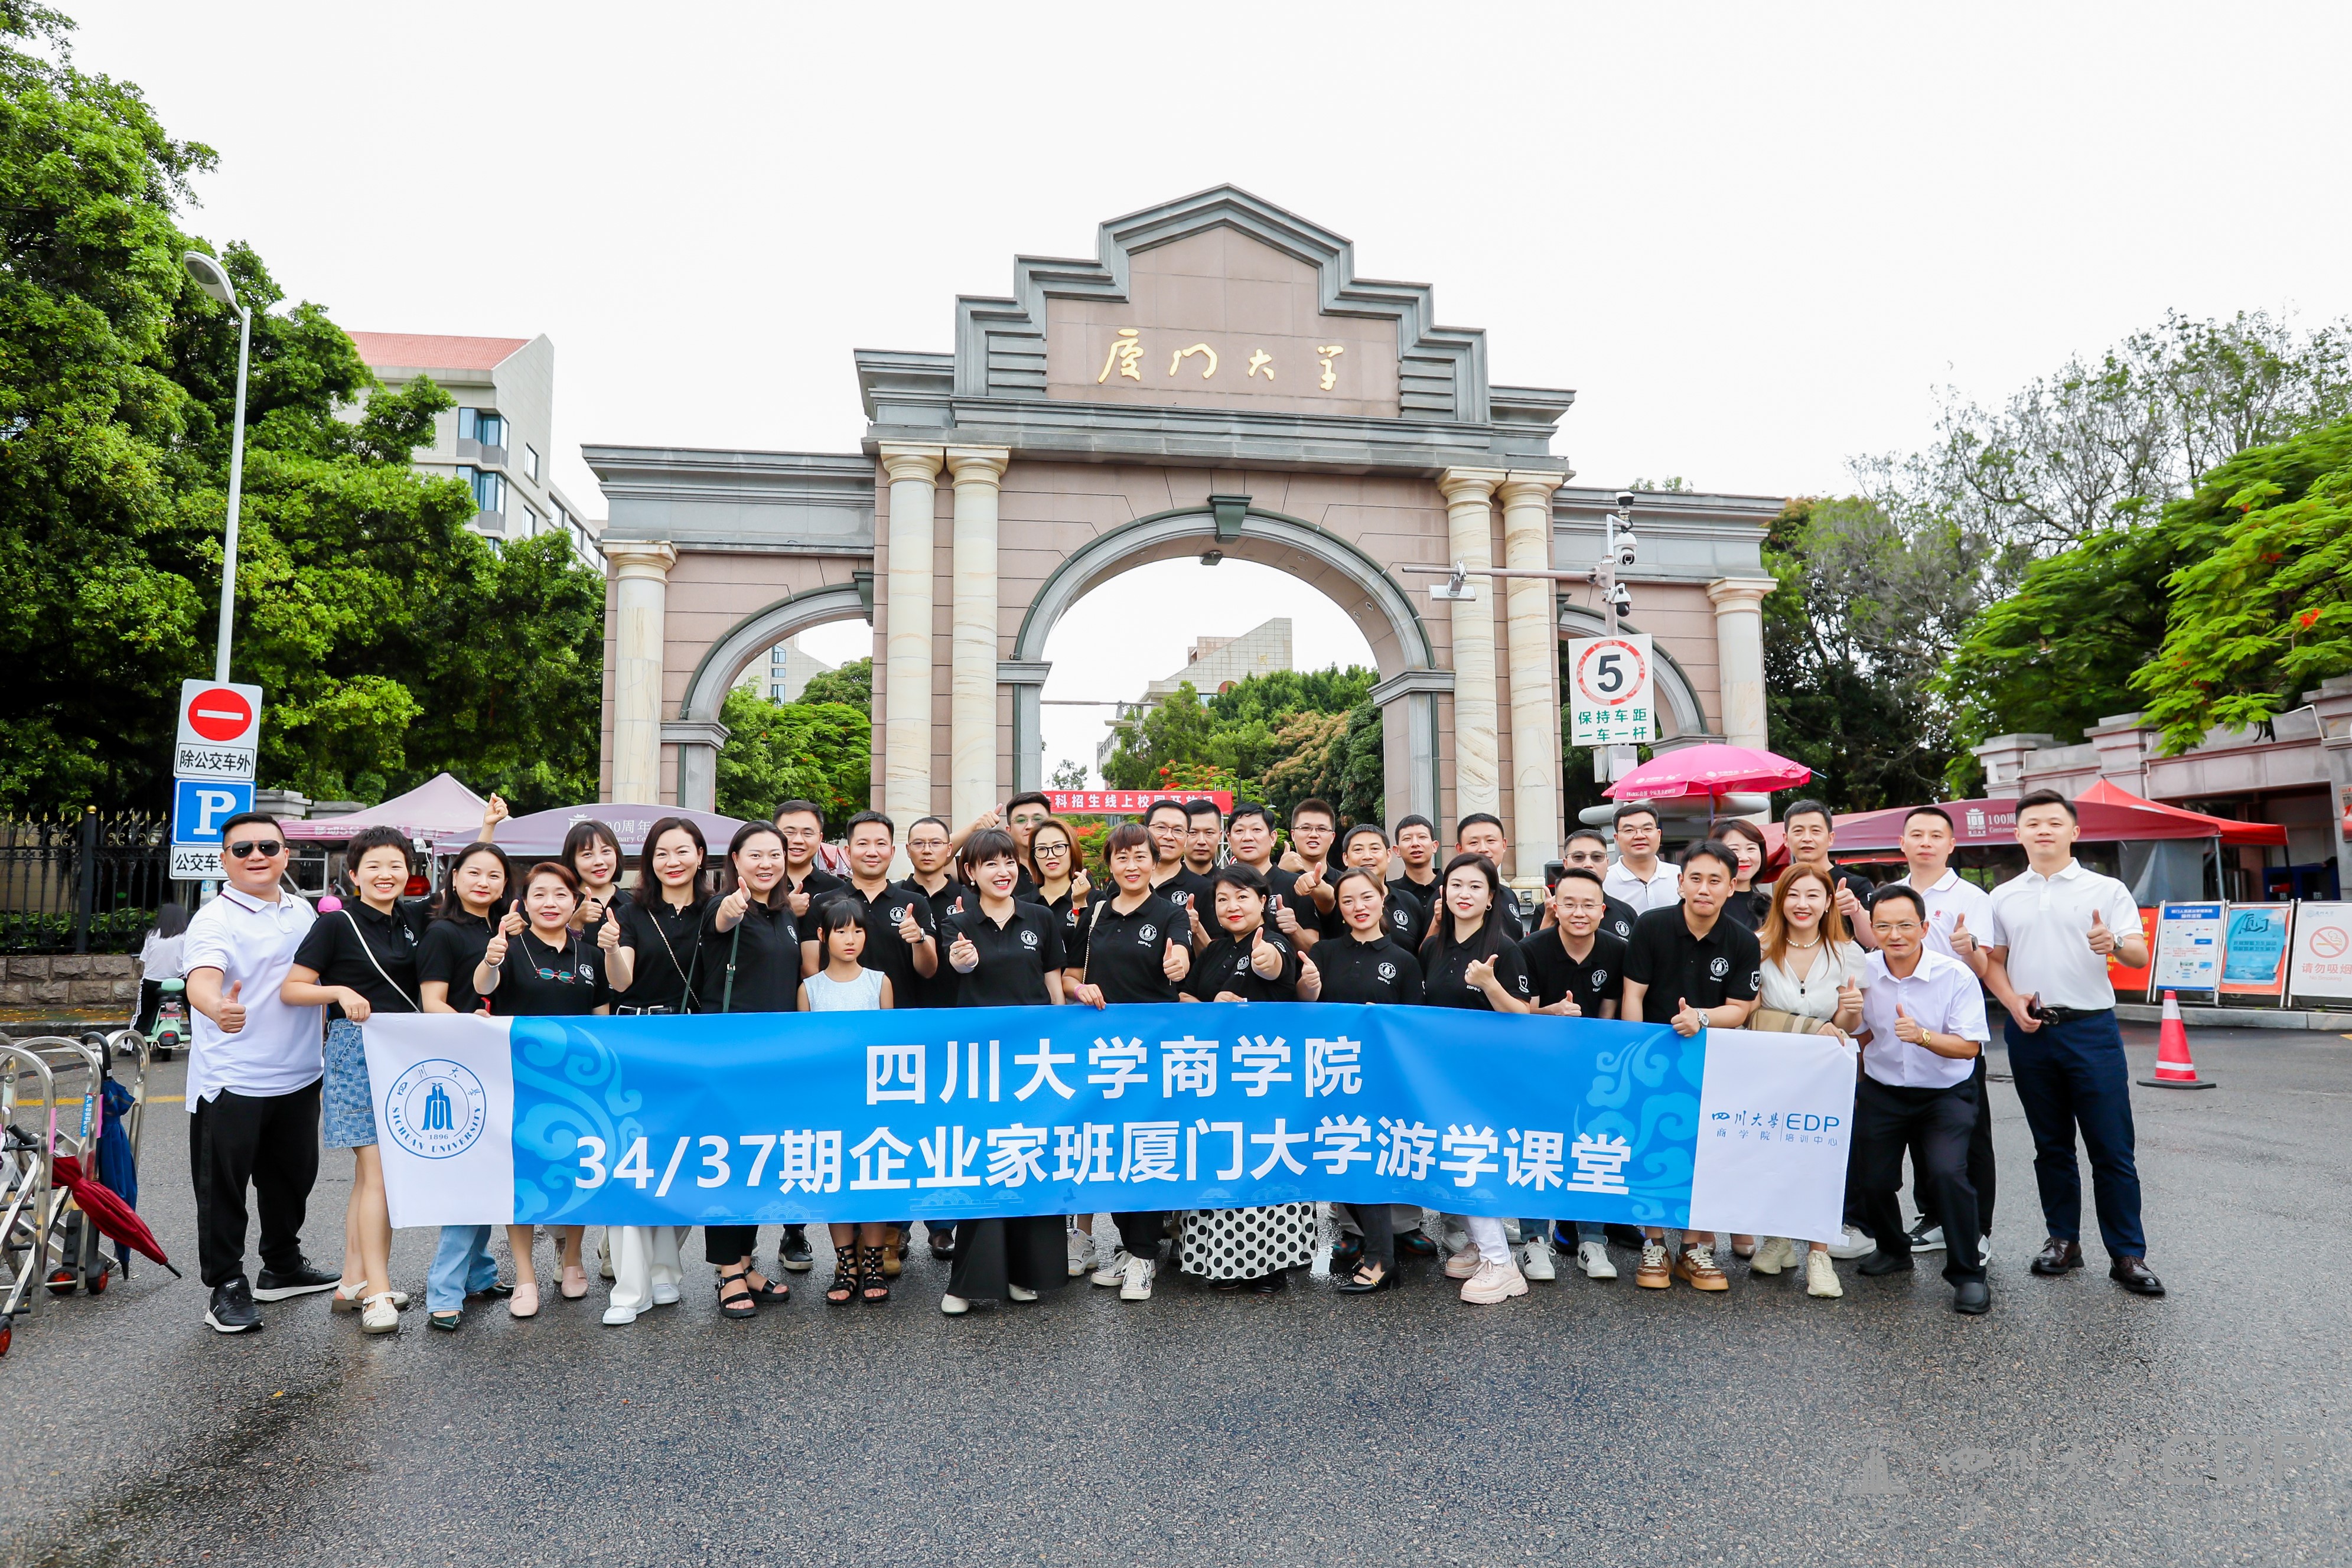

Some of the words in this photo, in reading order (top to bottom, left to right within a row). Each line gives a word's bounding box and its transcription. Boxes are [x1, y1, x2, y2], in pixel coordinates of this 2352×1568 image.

[1597, 654, 1623, 692] 5
[1578, 708, 1647, 725] 保持车距
[1578, 726, 1647, 742] 一车一杆
[179, 749, 251, 772] 除公交车外
[193, 790, 236, 836] P
[175, 853, 223, 872] 公交车
[2302, 963, 2352, 974] 请勿吸烟
[866, 1035, 1363, 1106] 四川大学商学院
[392, 1107, 425, 1150] SICHUAN
[431, 1106, 481, 1153] UNIVERSITY
[1786, 1113, 1840, 1132] EDP
[1716, 1127, 1770, 1140] 商学院
[1785, 1133, 1838, 1146] 培训中心
[575, 1114, 1631, 1197] 34/37期企业家班厦门大学游学课堂
